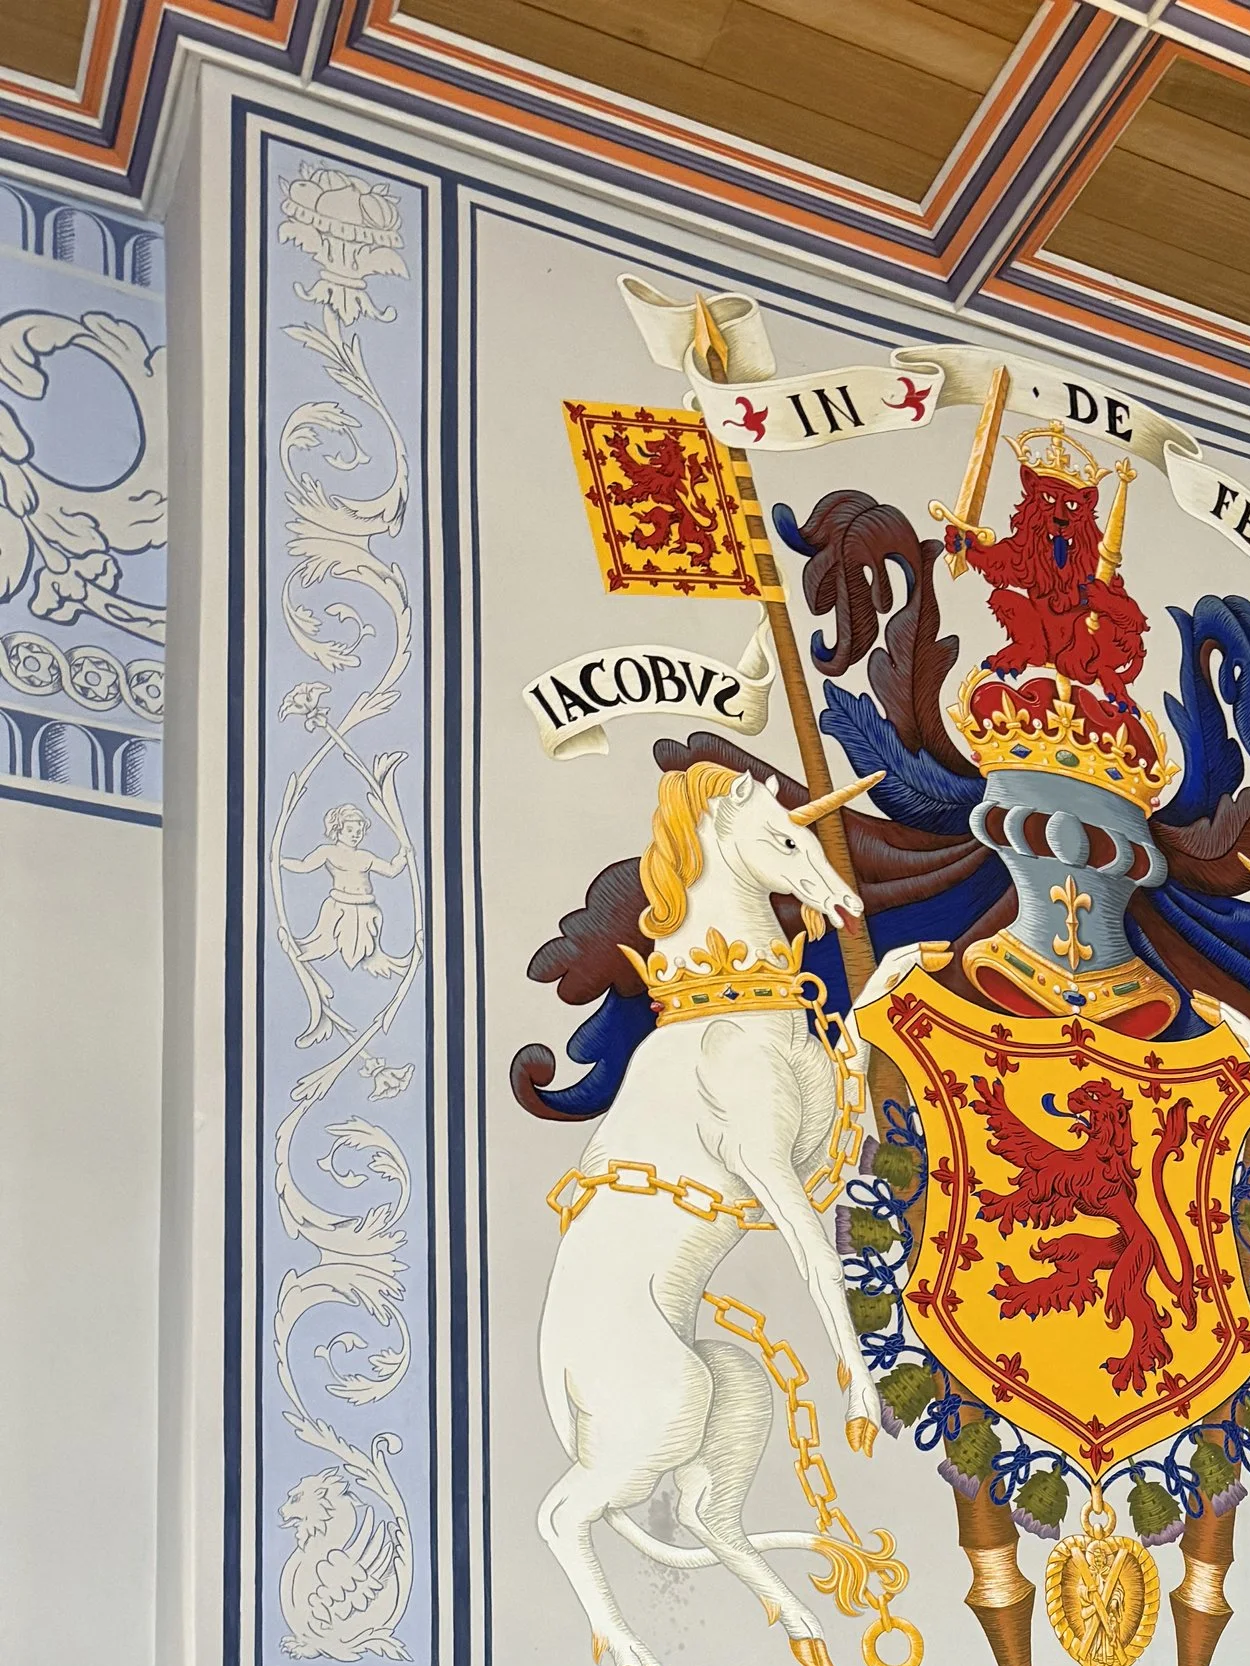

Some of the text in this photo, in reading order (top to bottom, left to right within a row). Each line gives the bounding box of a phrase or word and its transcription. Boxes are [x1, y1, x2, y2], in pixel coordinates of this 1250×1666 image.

[786, 385, 865, 438] IN
[1062, 382, 1133, 443] DE
[529, 654, 745, 730] IACOBVS
